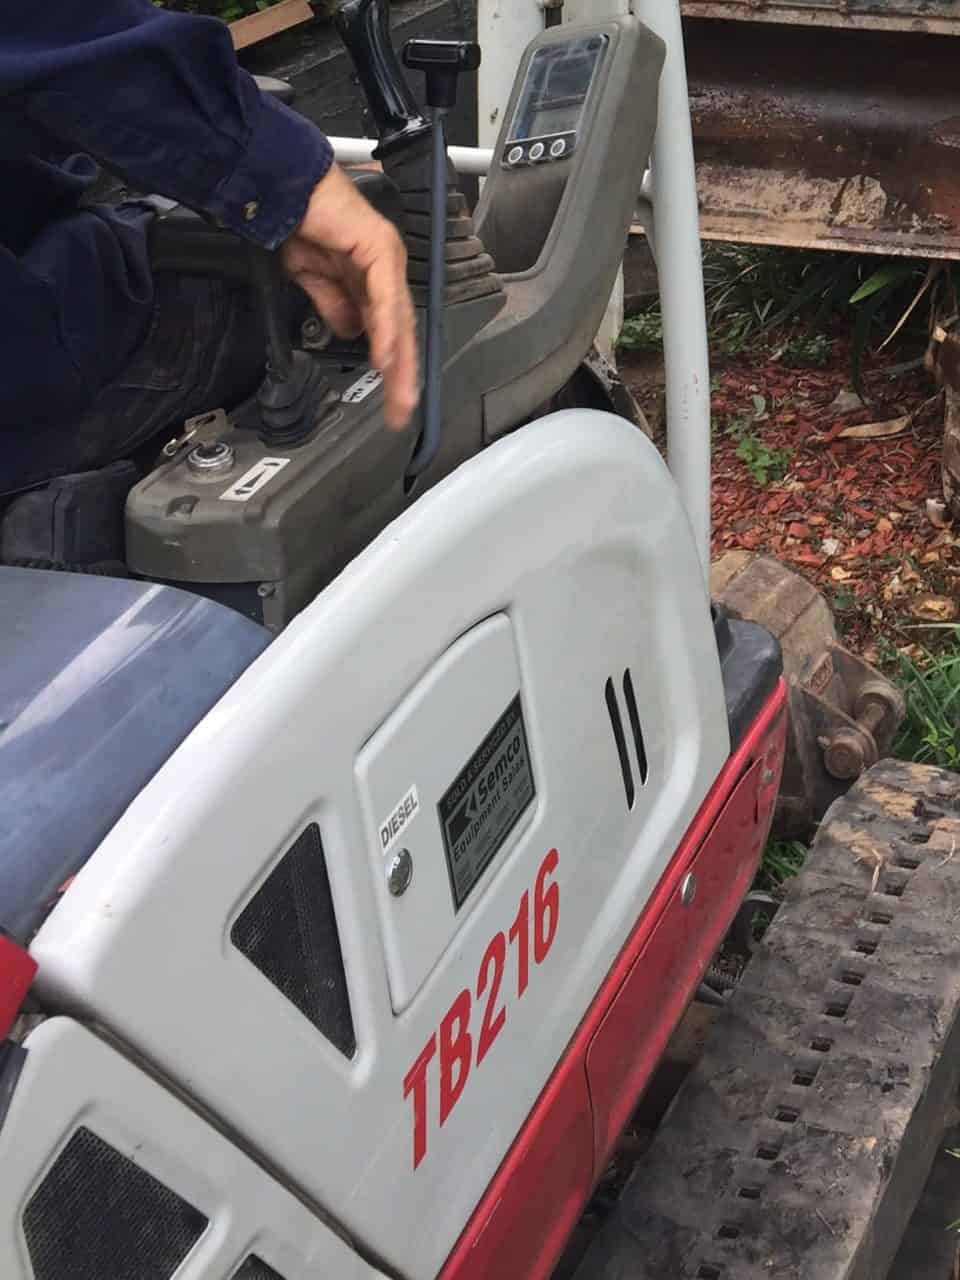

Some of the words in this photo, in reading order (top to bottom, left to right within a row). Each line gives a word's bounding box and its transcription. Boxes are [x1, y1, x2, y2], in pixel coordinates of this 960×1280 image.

[478, 735, 521, 806] Semco
[381, 792, 418, 849] DIESEL
[453, 790, 501, 863] Equipment
[403, 847, 559, 1171] TB216
